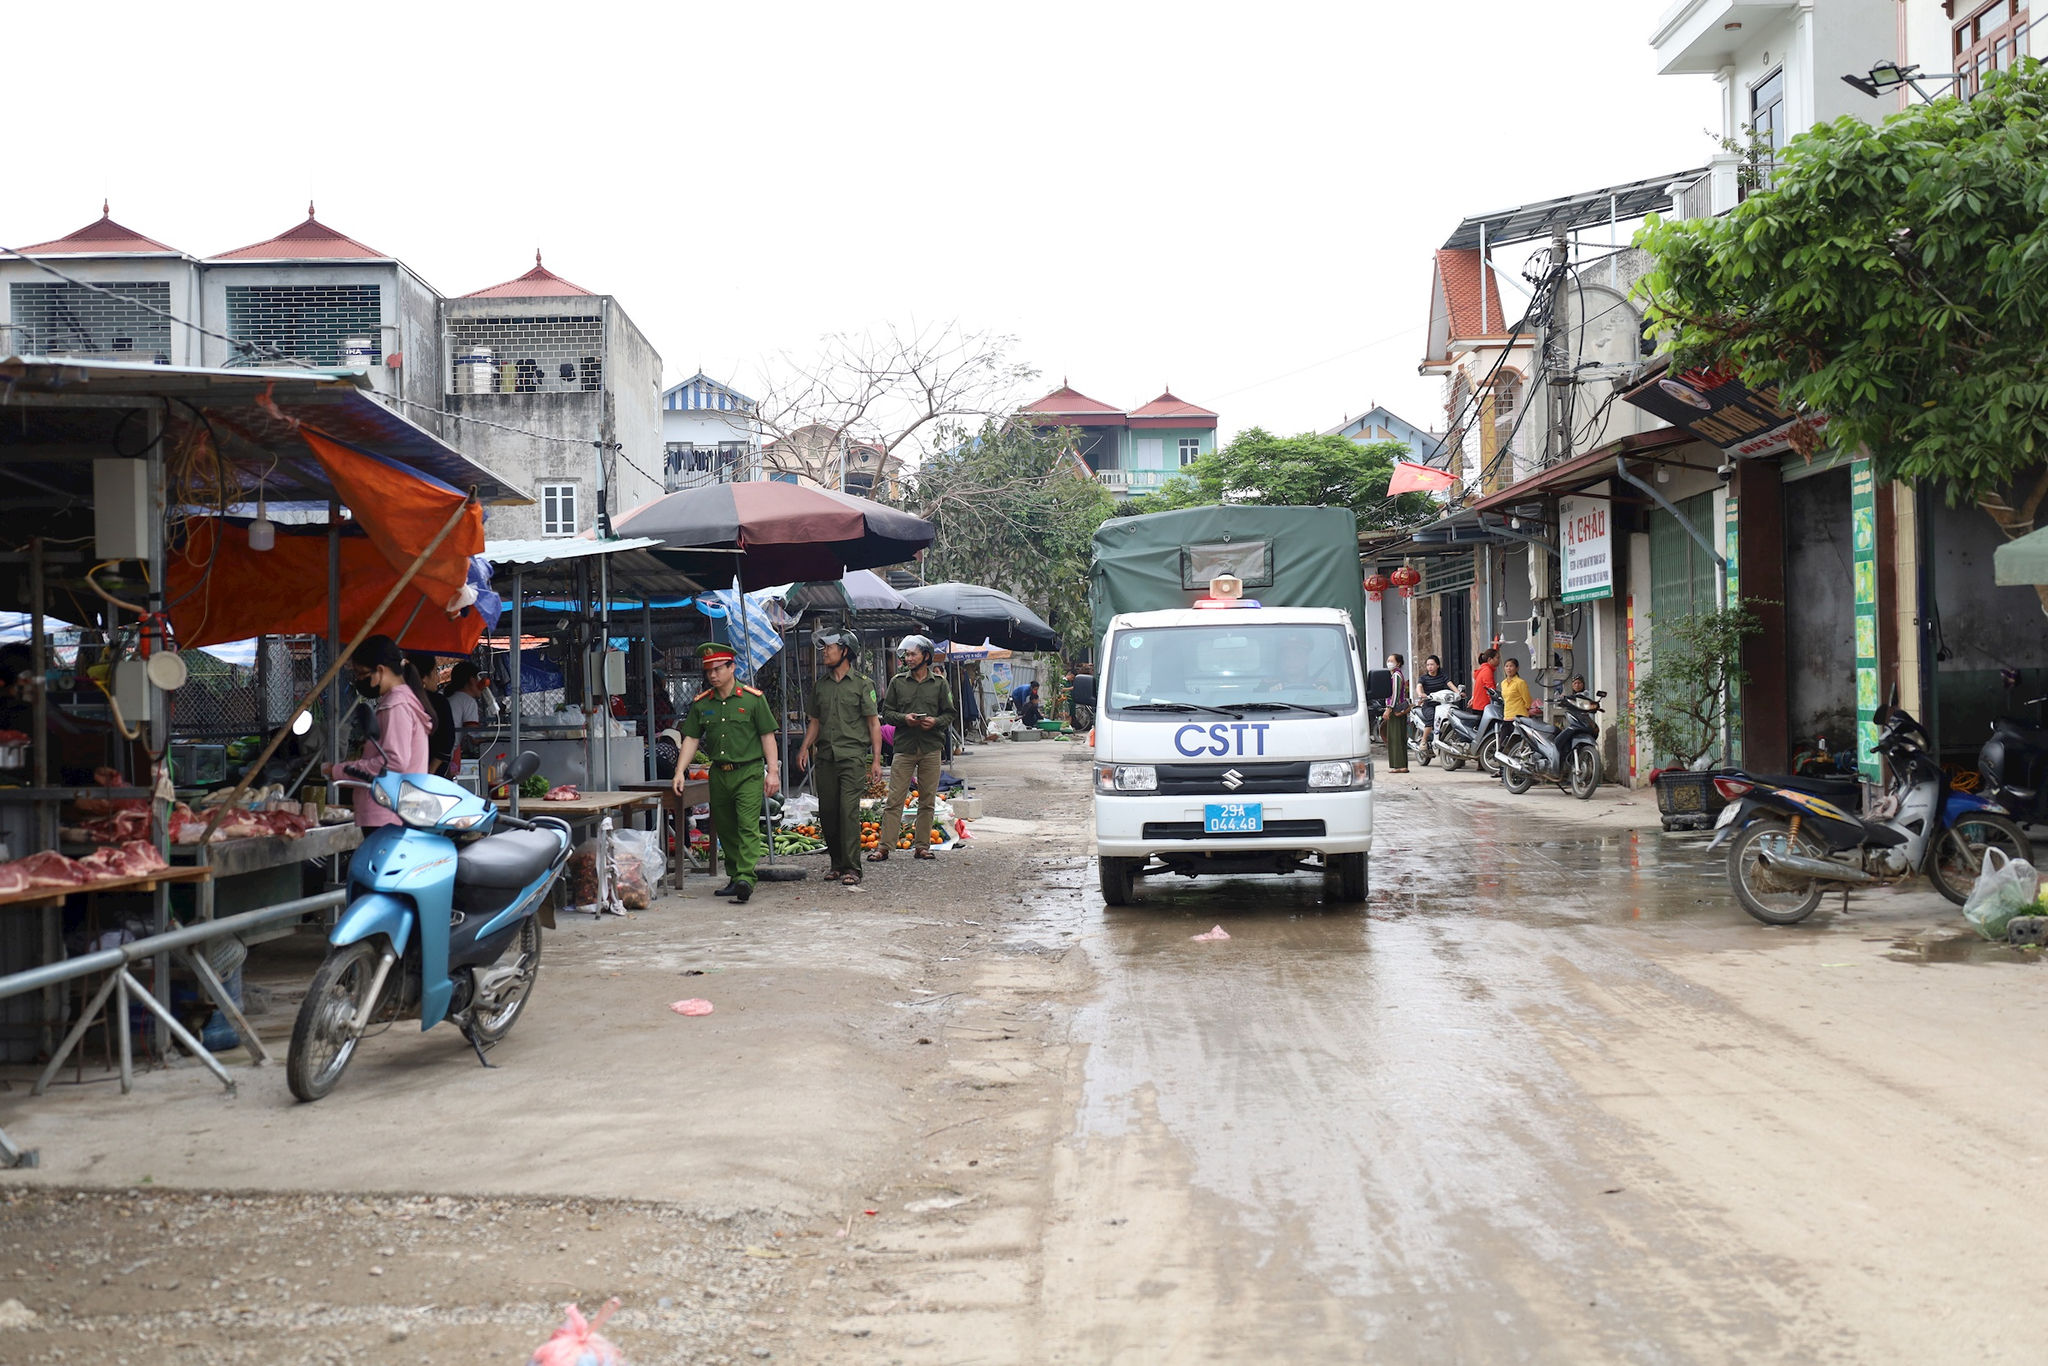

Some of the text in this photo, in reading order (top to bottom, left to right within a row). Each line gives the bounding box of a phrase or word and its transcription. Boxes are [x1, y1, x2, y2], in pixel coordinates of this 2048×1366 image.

[1568, 506, 1605, 546] Á CHÂU
[1174, 723, 1270, 757] CSTT
[1221, 804, 1245, 817] 29A
[1211, 817, 1256, 831] 044.48
